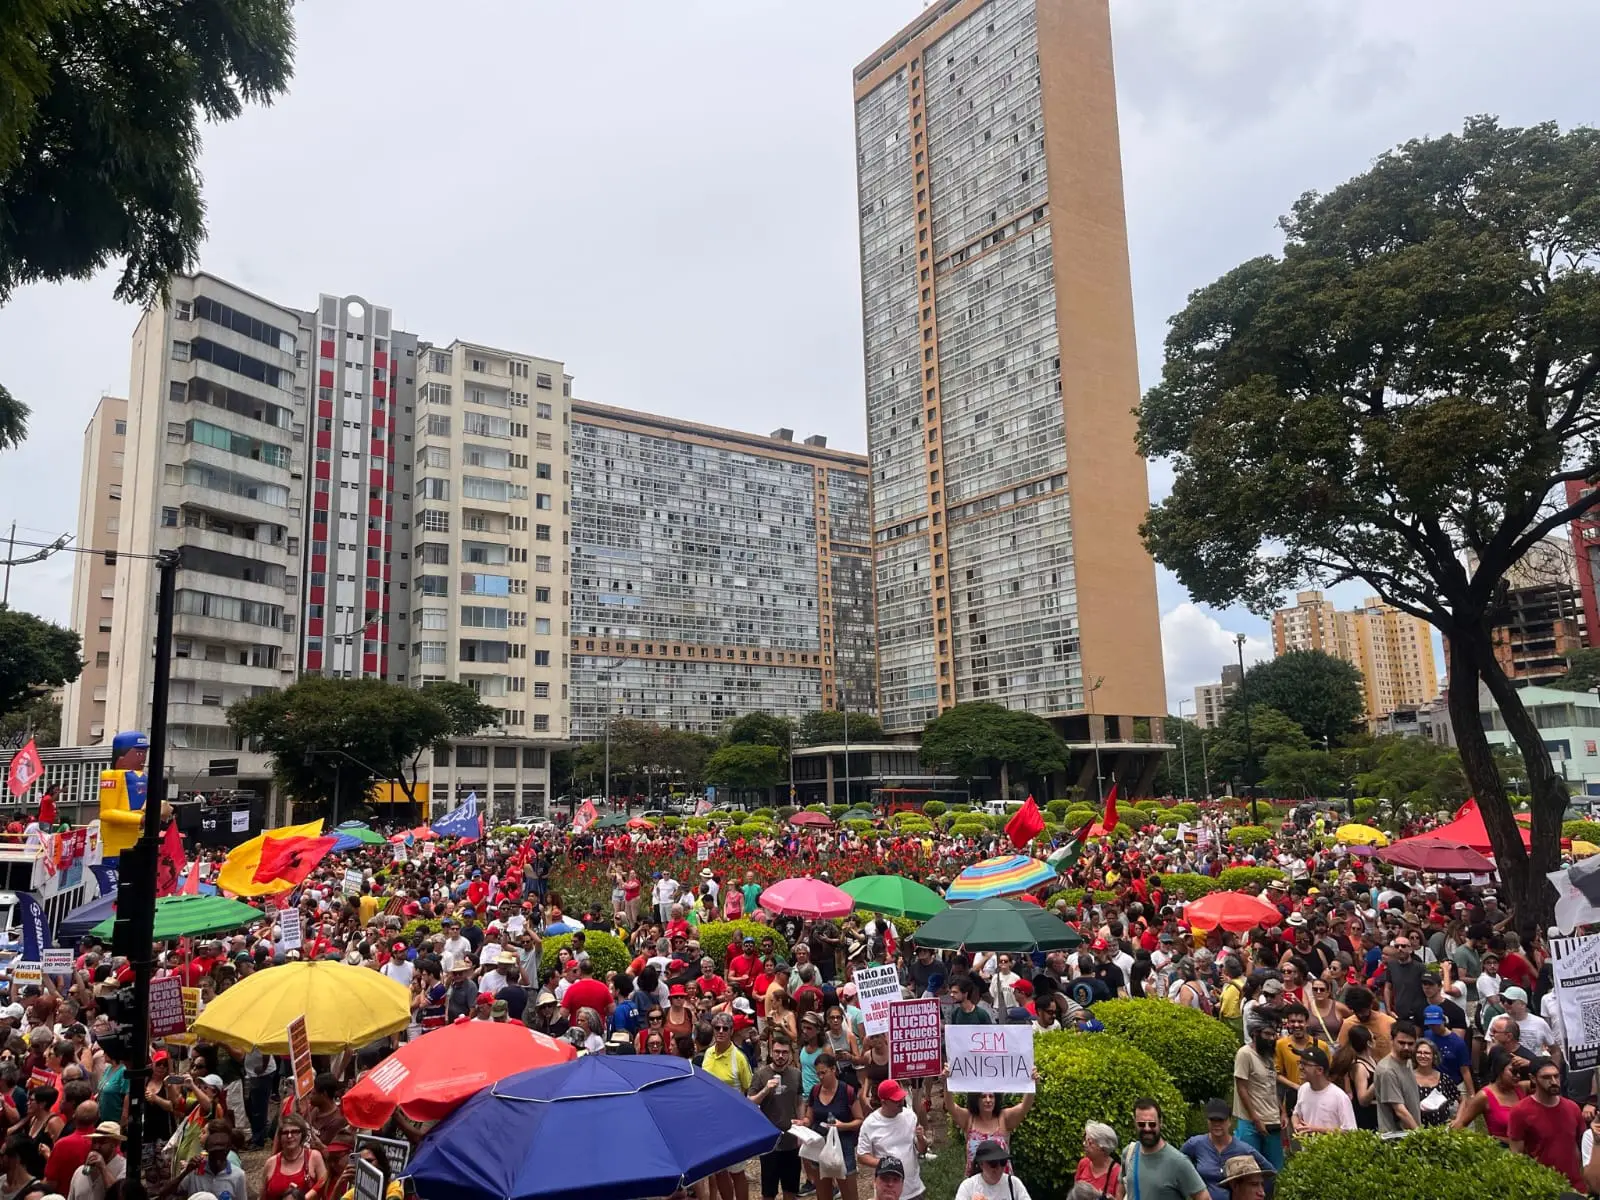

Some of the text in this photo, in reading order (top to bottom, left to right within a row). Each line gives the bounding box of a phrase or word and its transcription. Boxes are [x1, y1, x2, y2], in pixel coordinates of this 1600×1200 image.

[857, 966, 894, 981] NÃO AO
[860, 984, 899, 999] PRA DEVASTAR!
[891, 1005, 897, 1017] PL
[898, 1005, 905, 1017] DA
[892, 1014, 937, 1029] LUCRO
[892, 1026, 938, 1040] DE POUCOS
[893, 1038, 938, 1053] E PREJUÍZO
[971, 1031, 1006, 1051] SEM
[893, 1050, 938, 1064] DE TODOS!
[950, 1055, 1030, 1078] ANISTIA
